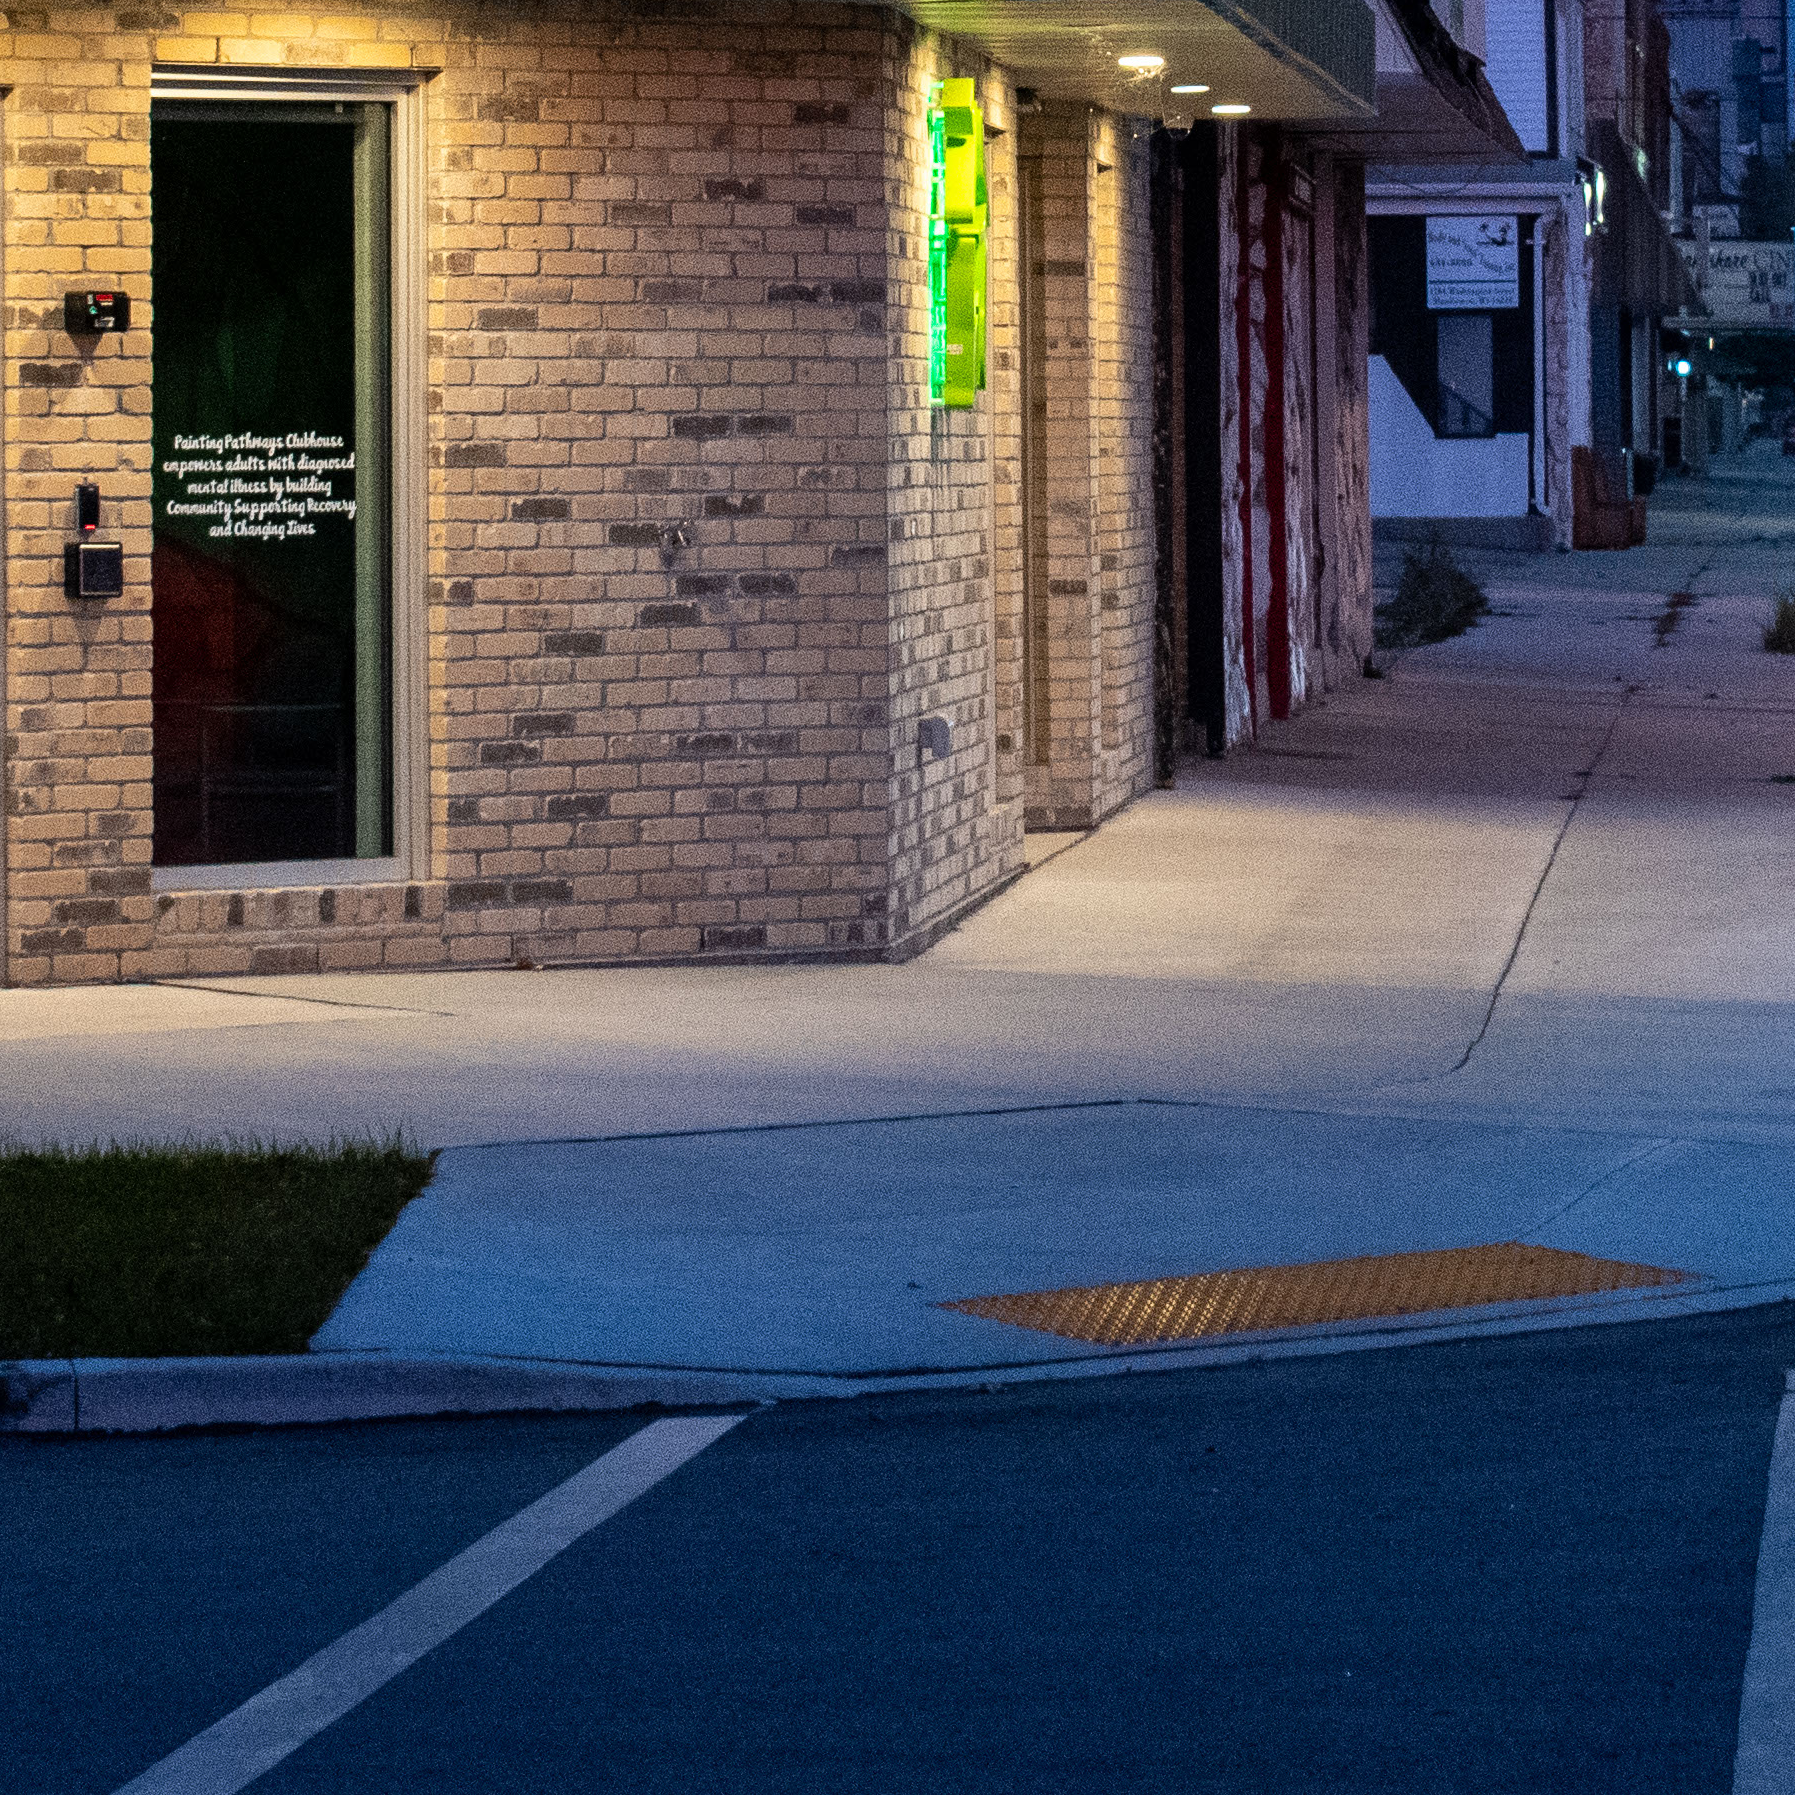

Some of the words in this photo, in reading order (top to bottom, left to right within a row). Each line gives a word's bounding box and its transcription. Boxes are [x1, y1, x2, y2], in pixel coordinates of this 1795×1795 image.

[174, 434, 223, 454] Painting
[224, 431, 284, 456] Pathways
[285, 431, 344, 449] Clubhouse
[163, 458, 223, 479] empowers
[224, 453, 266, 472] adults
[268, 453, 295, 471] with
[297, 452, 356, 474] diagnosed
[187, 478, 229, 494] mental
[230, 477, 268, 494] illness
[269, 476, 284, 501] by
[285, 476, 332, 497] building
[166, 500, 232, 522] Community
[234, 498, 305, 520] Supporting
[307, 497, 357, 520] Recovery
[209, 520, 232, 537] and
[234, 520, 286, 540] Changing
[287, 521, 316, 535] Lives
